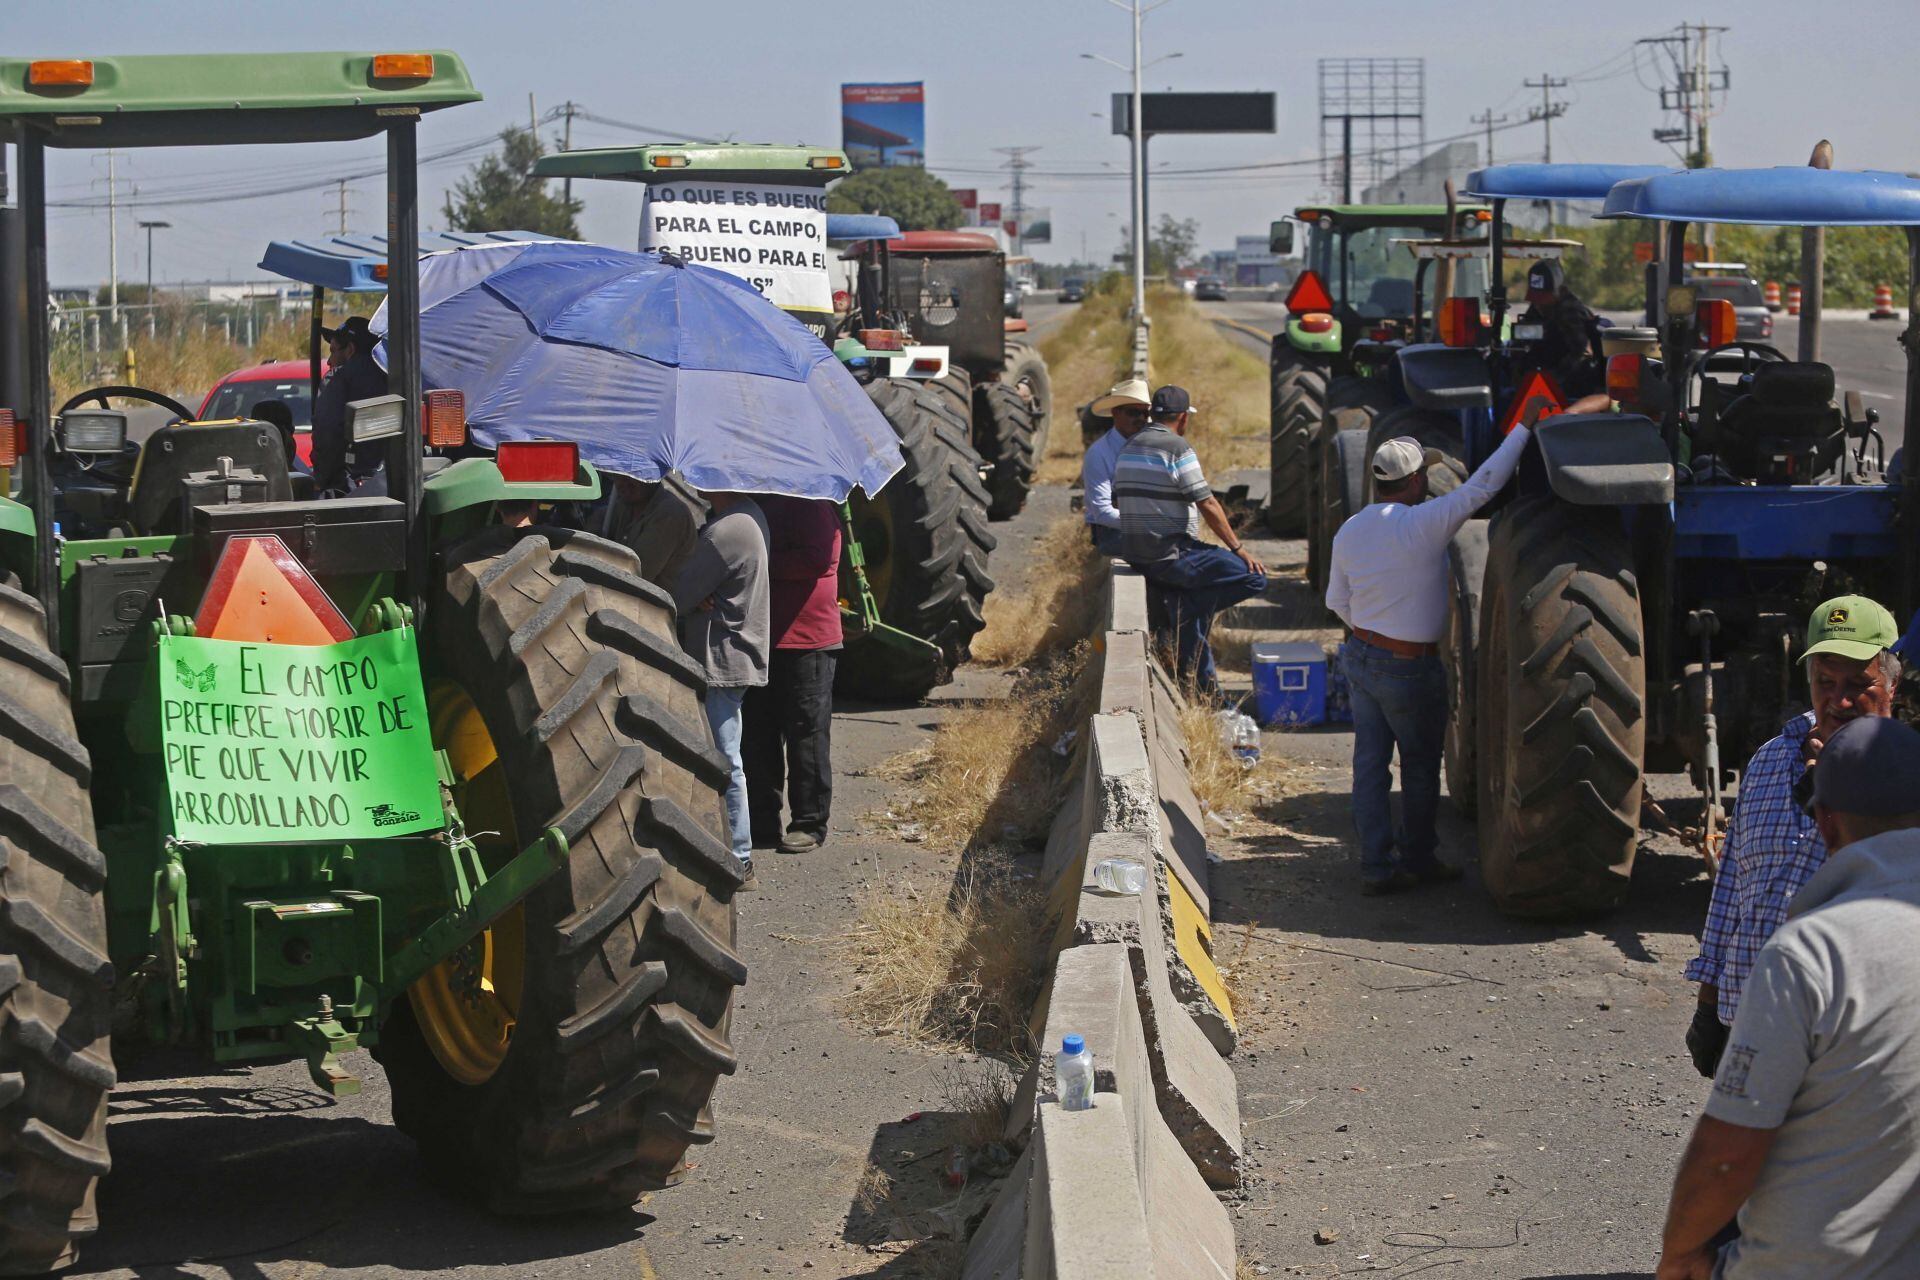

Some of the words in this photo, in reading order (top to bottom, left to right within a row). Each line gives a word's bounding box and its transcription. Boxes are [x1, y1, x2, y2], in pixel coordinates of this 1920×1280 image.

[683, 189, 726, 205] QUE
[732, 191, 757, 206] ES
[655, 216, 712, 233] PARA
[718, 218, 743, 234] EL
[749, 220, 821, 243] CAMPO,
[680, 246, 751, 263] BUENO
[759, 249, 808, 267] PARA
[240, 647, 278, 696] EL
[287, 656, 378, 697] CAMPO
[164, 700, 279, 739] PREFIERE
[285, 704, 370, 739] MORIR
[378, 695, 413, 734] DE
[166, 742, 206, 780] PIE
[219, 747, 271, 781] QUE
[279, 748, 370, 783] VIVIR
[174, 791, 350, 828] ARRODILLADO
